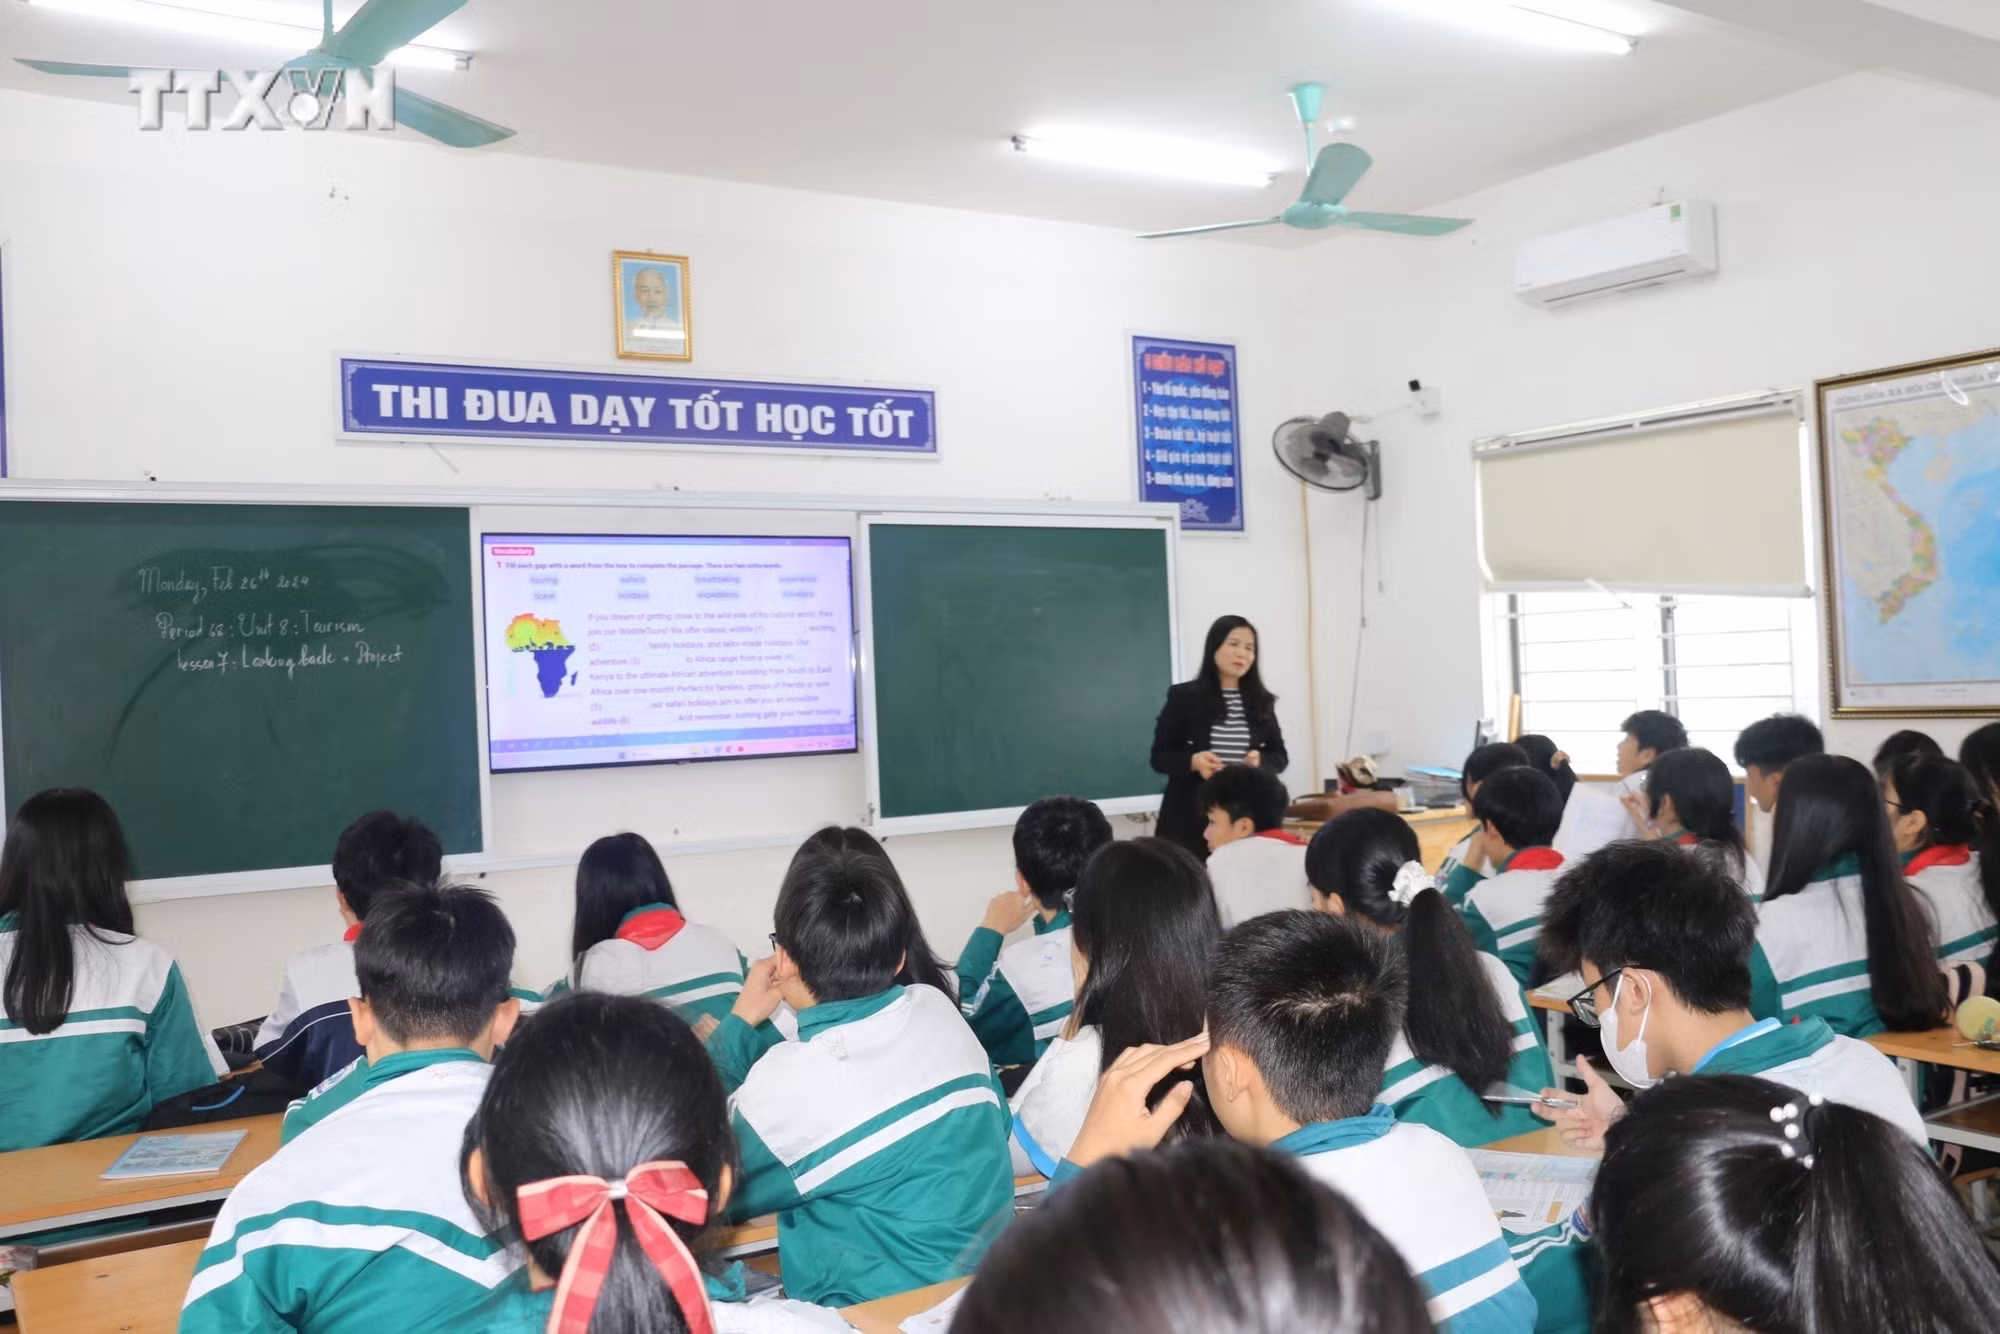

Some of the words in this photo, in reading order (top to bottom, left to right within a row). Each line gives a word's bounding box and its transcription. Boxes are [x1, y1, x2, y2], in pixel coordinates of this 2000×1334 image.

[372, 384, 448, 419] THI
[463, 388, 556, 424] ĐUA
[570, 393, 656, 434] DẠY
[668, 389, 743, 431] TỐT
[756, 402, 836, 440] HỌC
[846, 399, 914, 438] TỐT
[139, 566, 207, 604] Monday,
[277, 574, 309, 589] 2024
[238, 612, 274, 637] Unit
